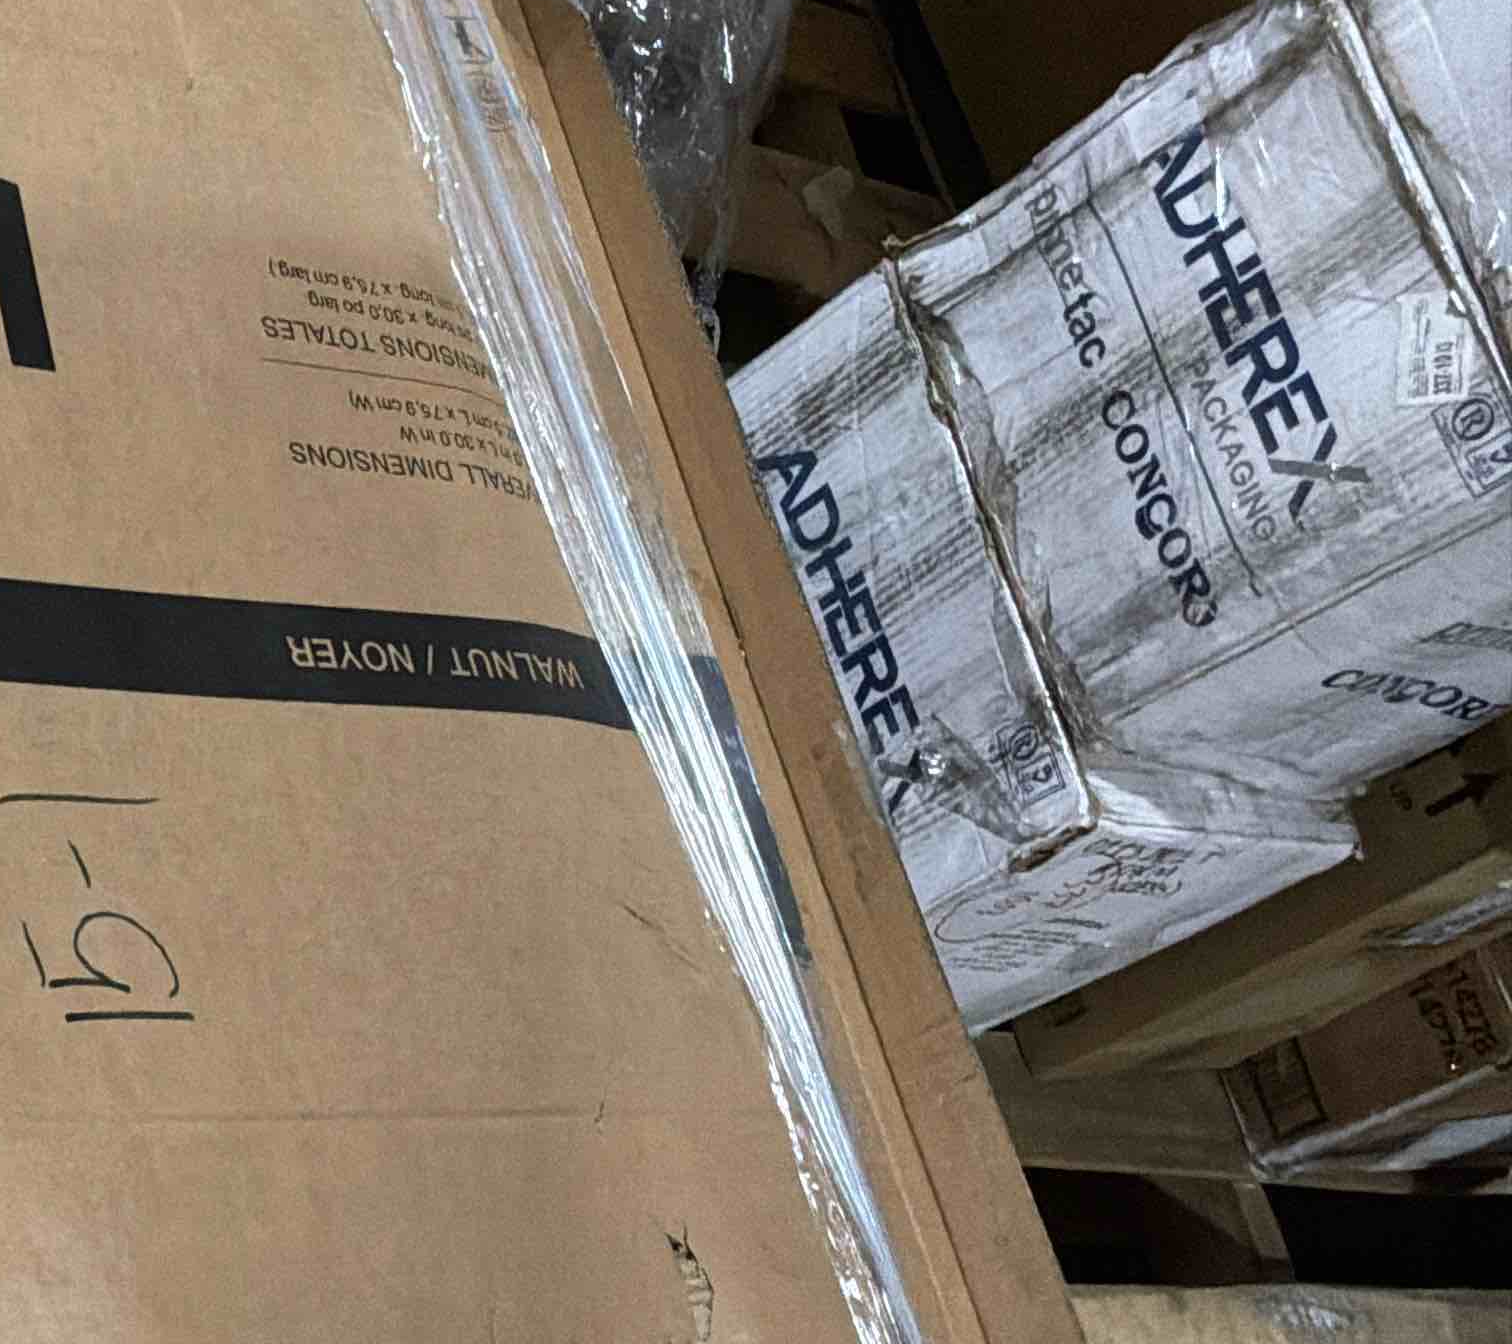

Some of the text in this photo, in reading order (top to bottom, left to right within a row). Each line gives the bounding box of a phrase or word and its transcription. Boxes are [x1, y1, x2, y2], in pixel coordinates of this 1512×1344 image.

[261, 314, 375, 353] TOTALES
[1143, 124, 1372, 524] ADHEREX
[289, 441, 453, 483] DIMENSIONS
[1185, 358, 1279, 545] PACKAGING
[756, 449, 932, 811] ADHEREX
[287, 634, 416, 674] NOYER
[450, 649, 585, 690] WALNUT
